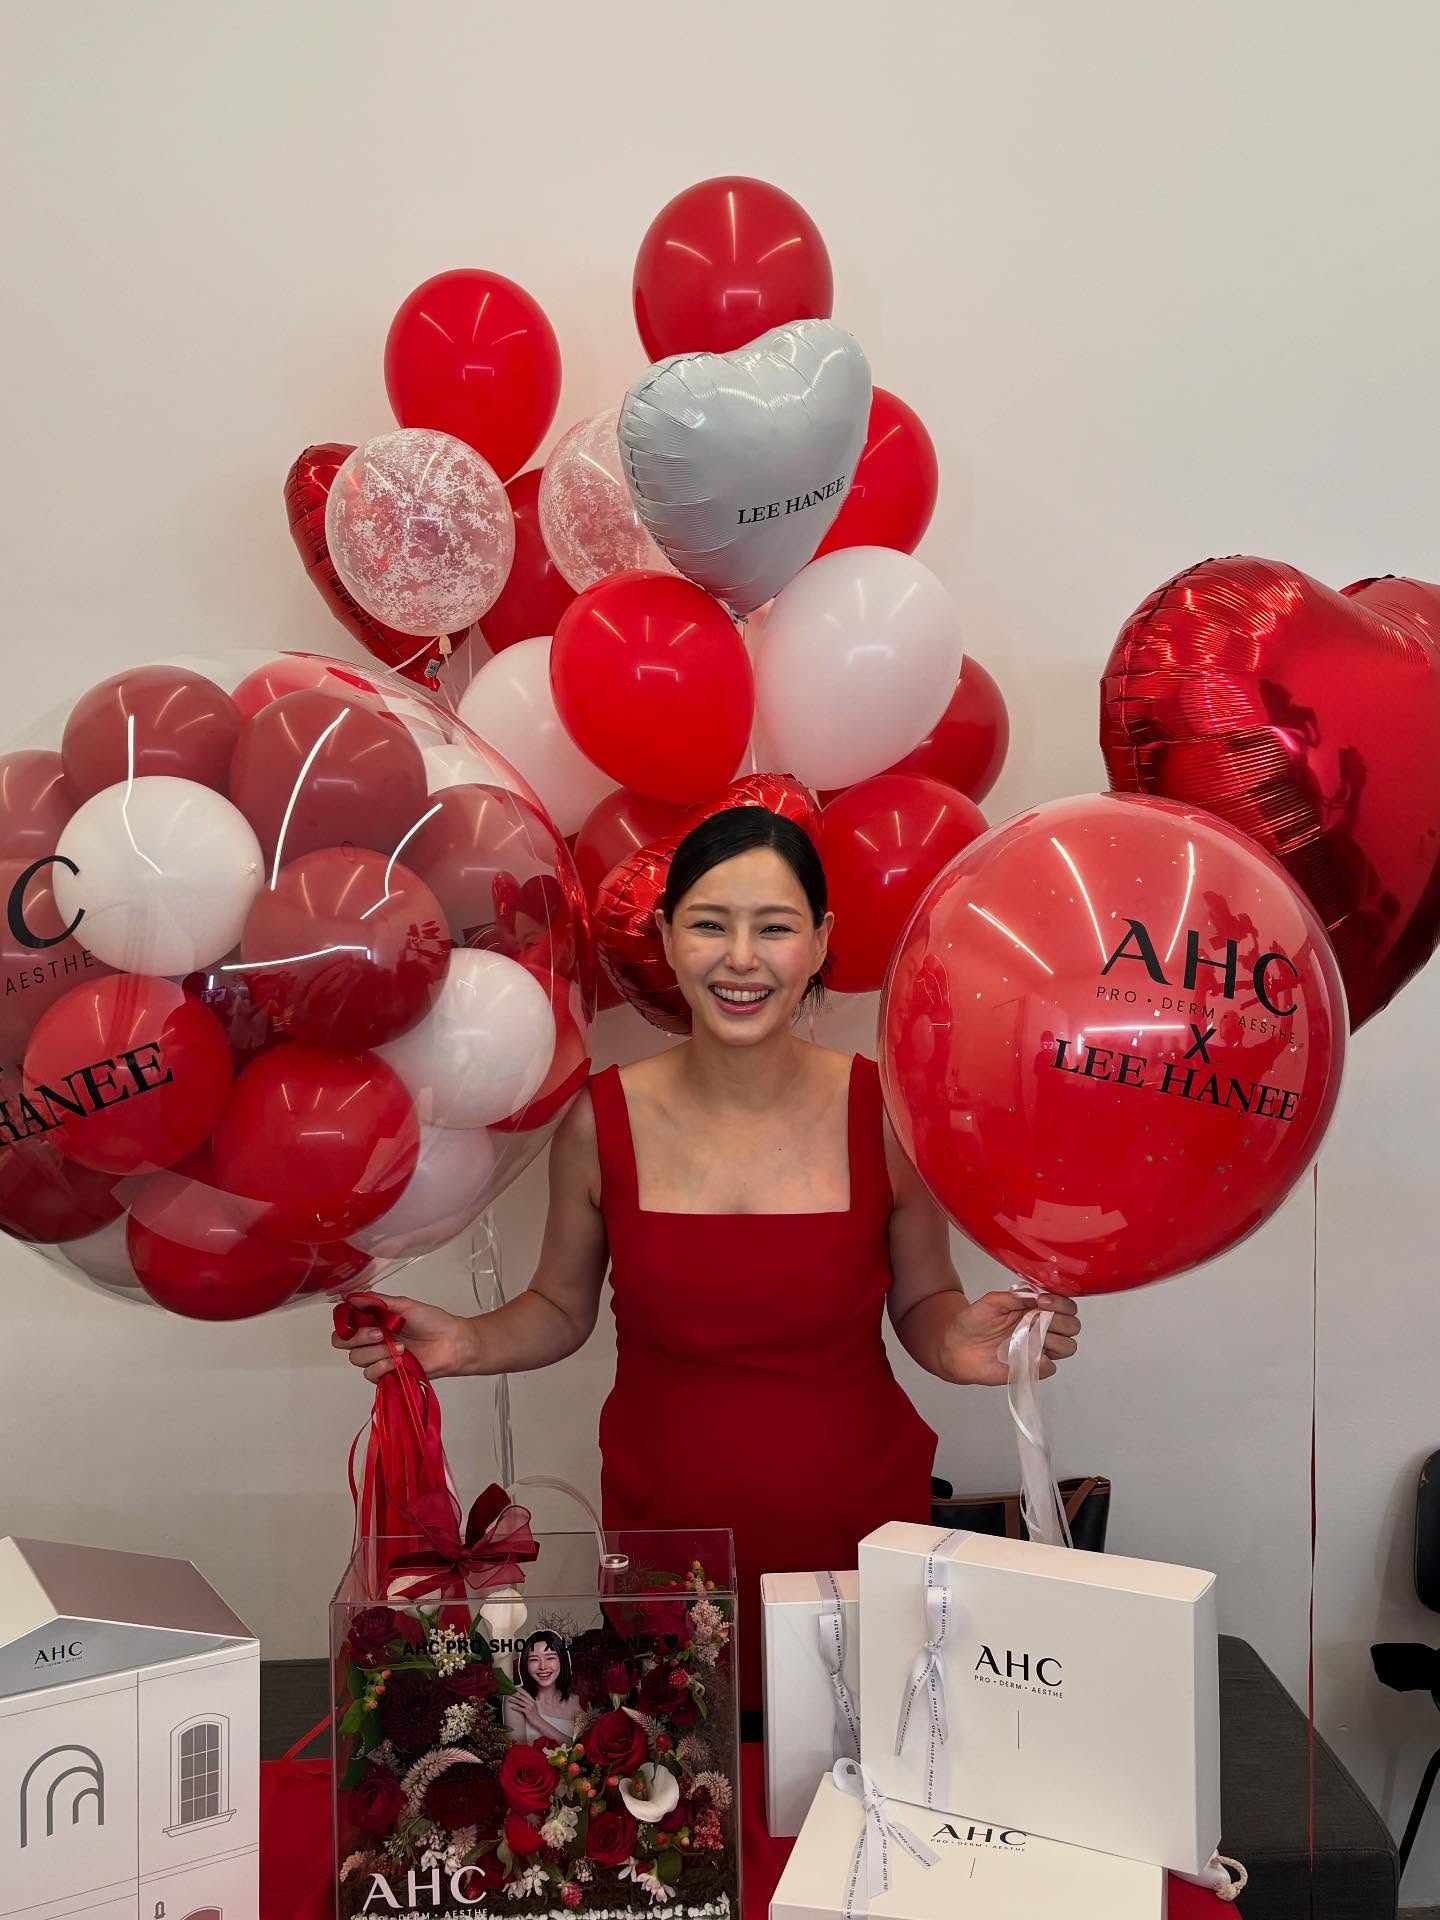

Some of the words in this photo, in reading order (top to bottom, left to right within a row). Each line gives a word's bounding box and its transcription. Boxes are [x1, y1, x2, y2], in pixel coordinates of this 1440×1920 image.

[736, 502, 780, 525] LEE
[784, 475, 845, 515] HANEE
[5, 949, 94, 996] AESTHE
[1100, 918, 1298, 1016] AHC
[1096, 986, 1137, 1003] PRO
[1162, 997, 1215, 1020] DERM
[1239, 1015, 1297, 1044] AESTHE
[1183, 1023, 1217, 1064] X
[1050, 1038, 1148, 1089] LEE
[1156, 1061, 1300, 1122] HANEE
[34, 1641, 83, 1665] AHC
[403, 1639, 440, 1656] AHC
[446, 1639, 481, 1654] PRO
[974, 1644, 1063, 1687] AHC
[974, 1674, 991, 1684] PRO
[999, 1680, 1022, 1690] DERM
[1031, 1687, 1063, 1699] AESTHE
[932, 1823, 1028, 1846] AHC
[363, 1866, 487, 1914] AHC
[444, 1908, 488, 1919] AESTHE
